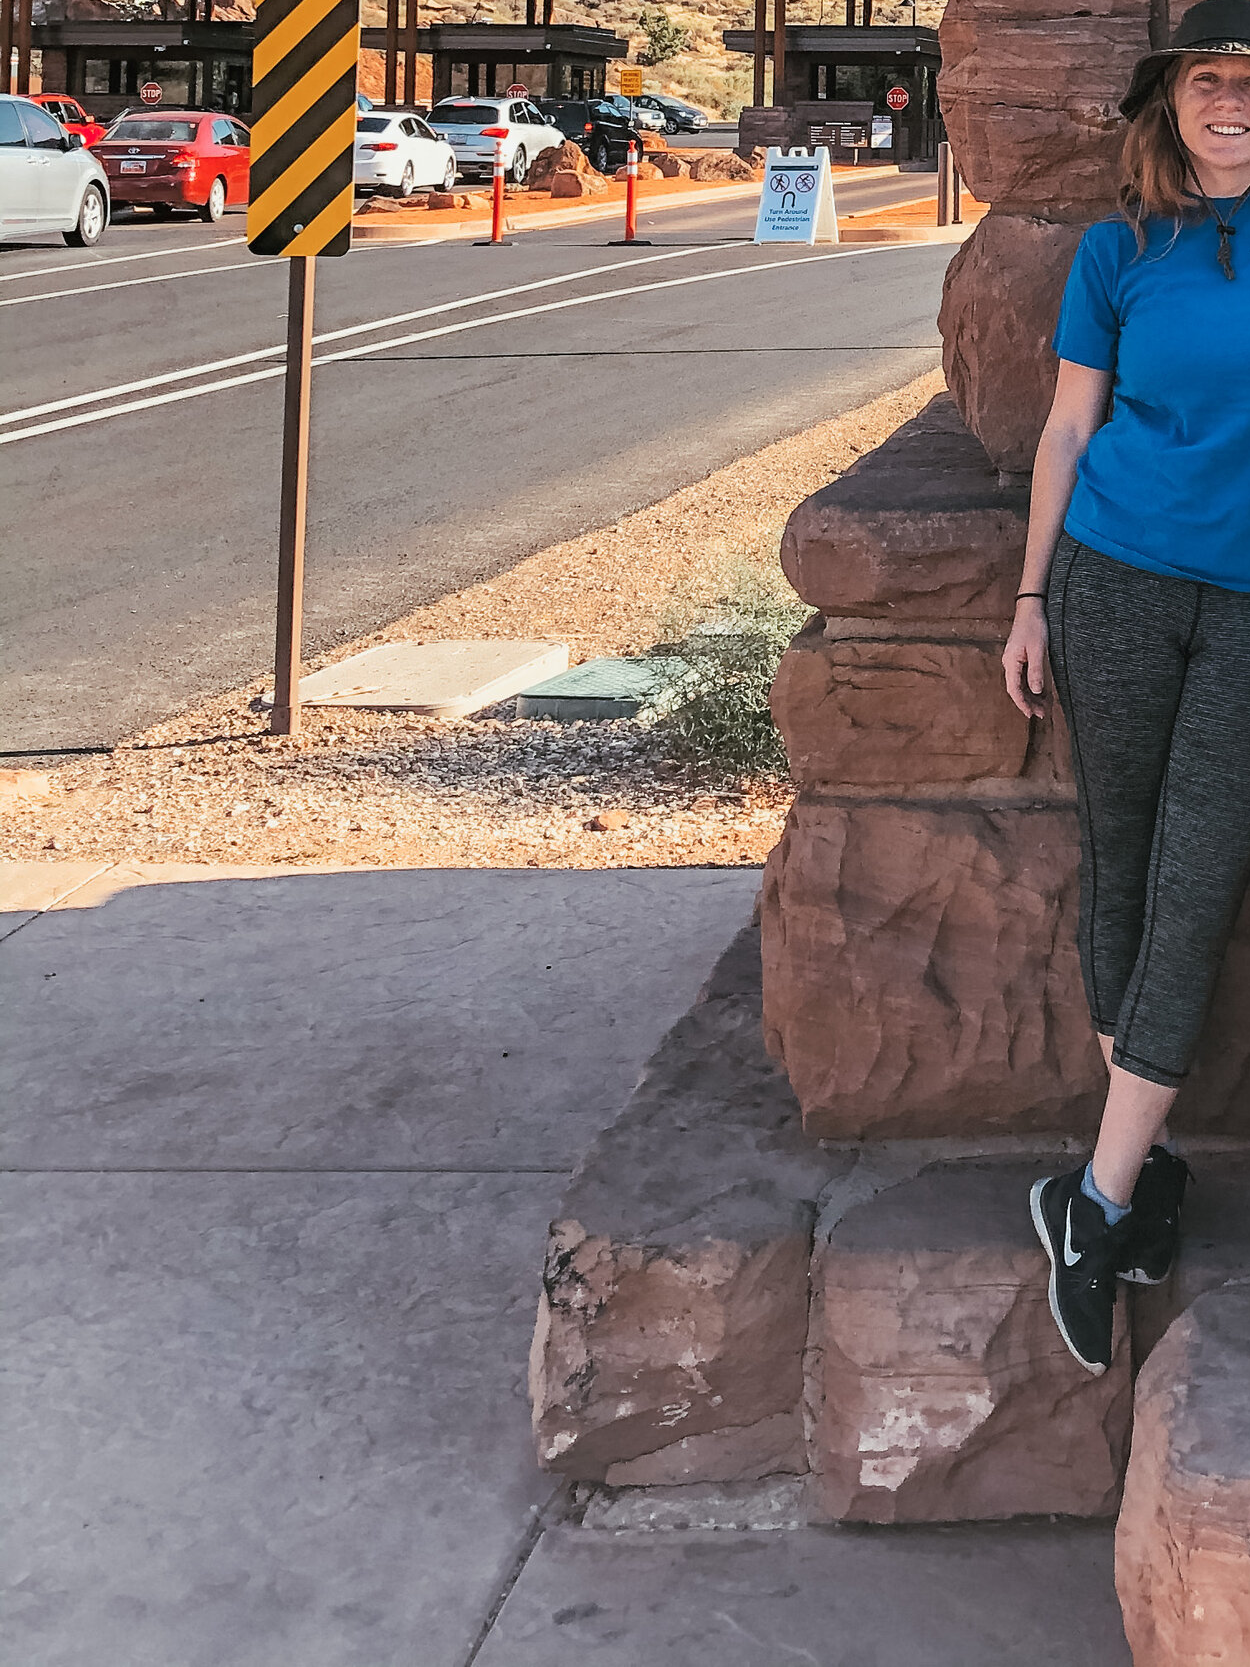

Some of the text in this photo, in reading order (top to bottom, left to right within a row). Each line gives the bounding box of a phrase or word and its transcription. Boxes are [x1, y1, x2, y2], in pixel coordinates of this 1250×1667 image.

[142, 89, 161, 98] STOP
[508, 90, 528, 99] STOP
[888, 94, 908, 103] STOP
